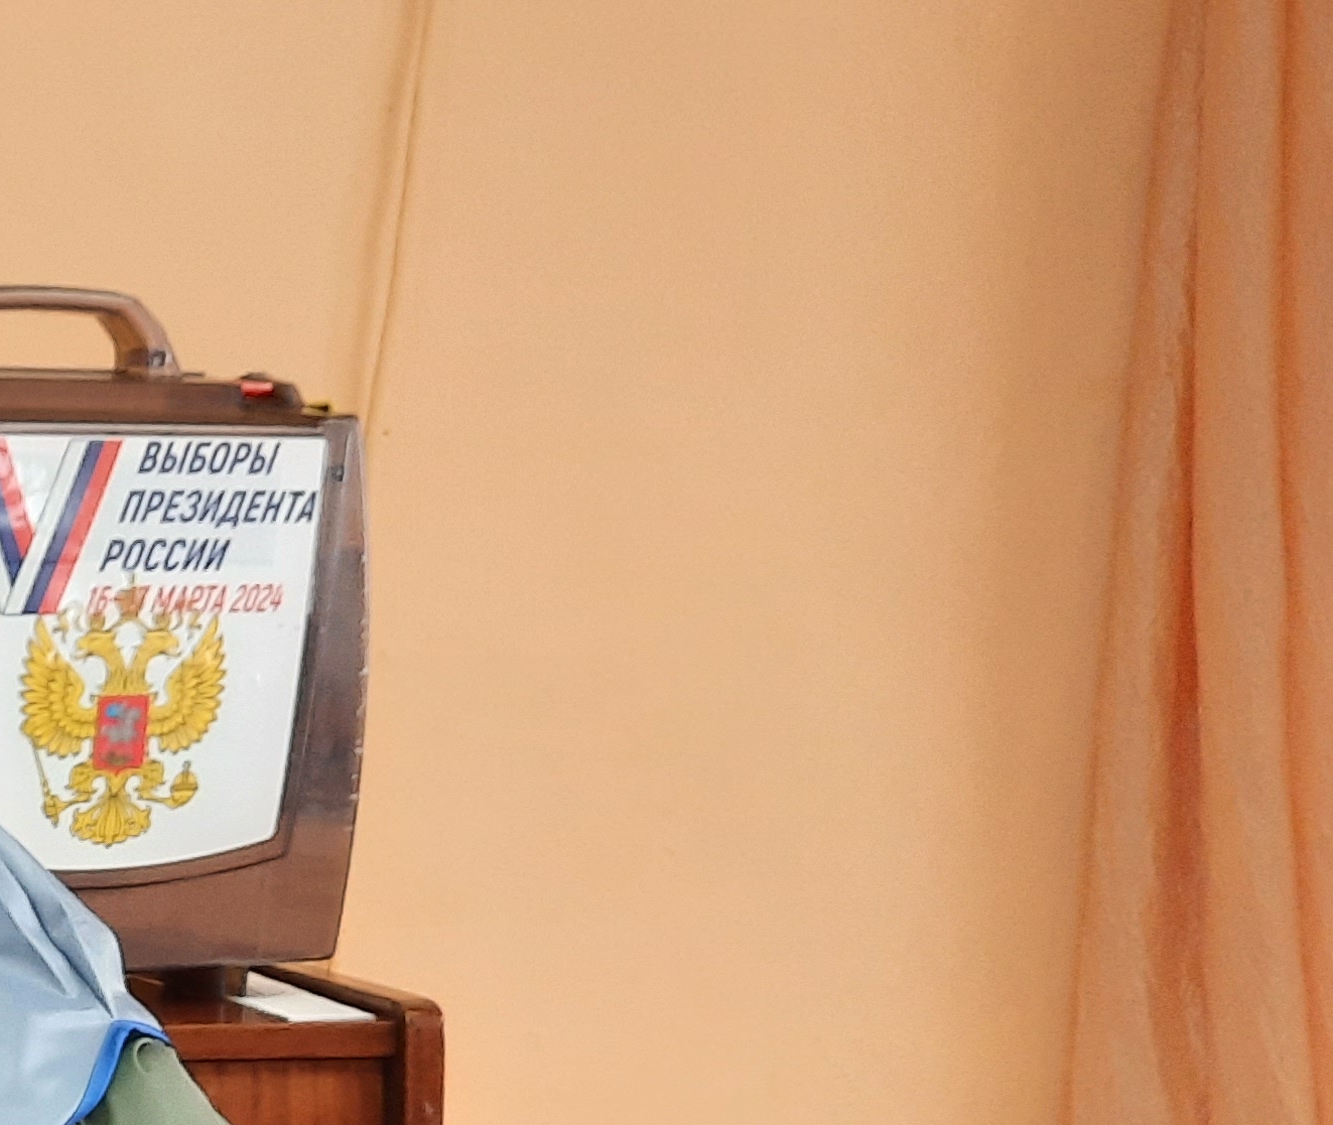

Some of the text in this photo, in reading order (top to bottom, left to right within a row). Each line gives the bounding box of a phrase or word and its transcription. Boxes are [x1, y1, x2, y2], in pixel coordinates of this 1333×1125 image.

[137, 440, 282, 476] ВЫБОРЫ
[118, 489, 319, 529] ПРЕЗИДЕНТА
[98, 537, 231, 573] РОССИИ
[229, 583, 284, 613] 2024
